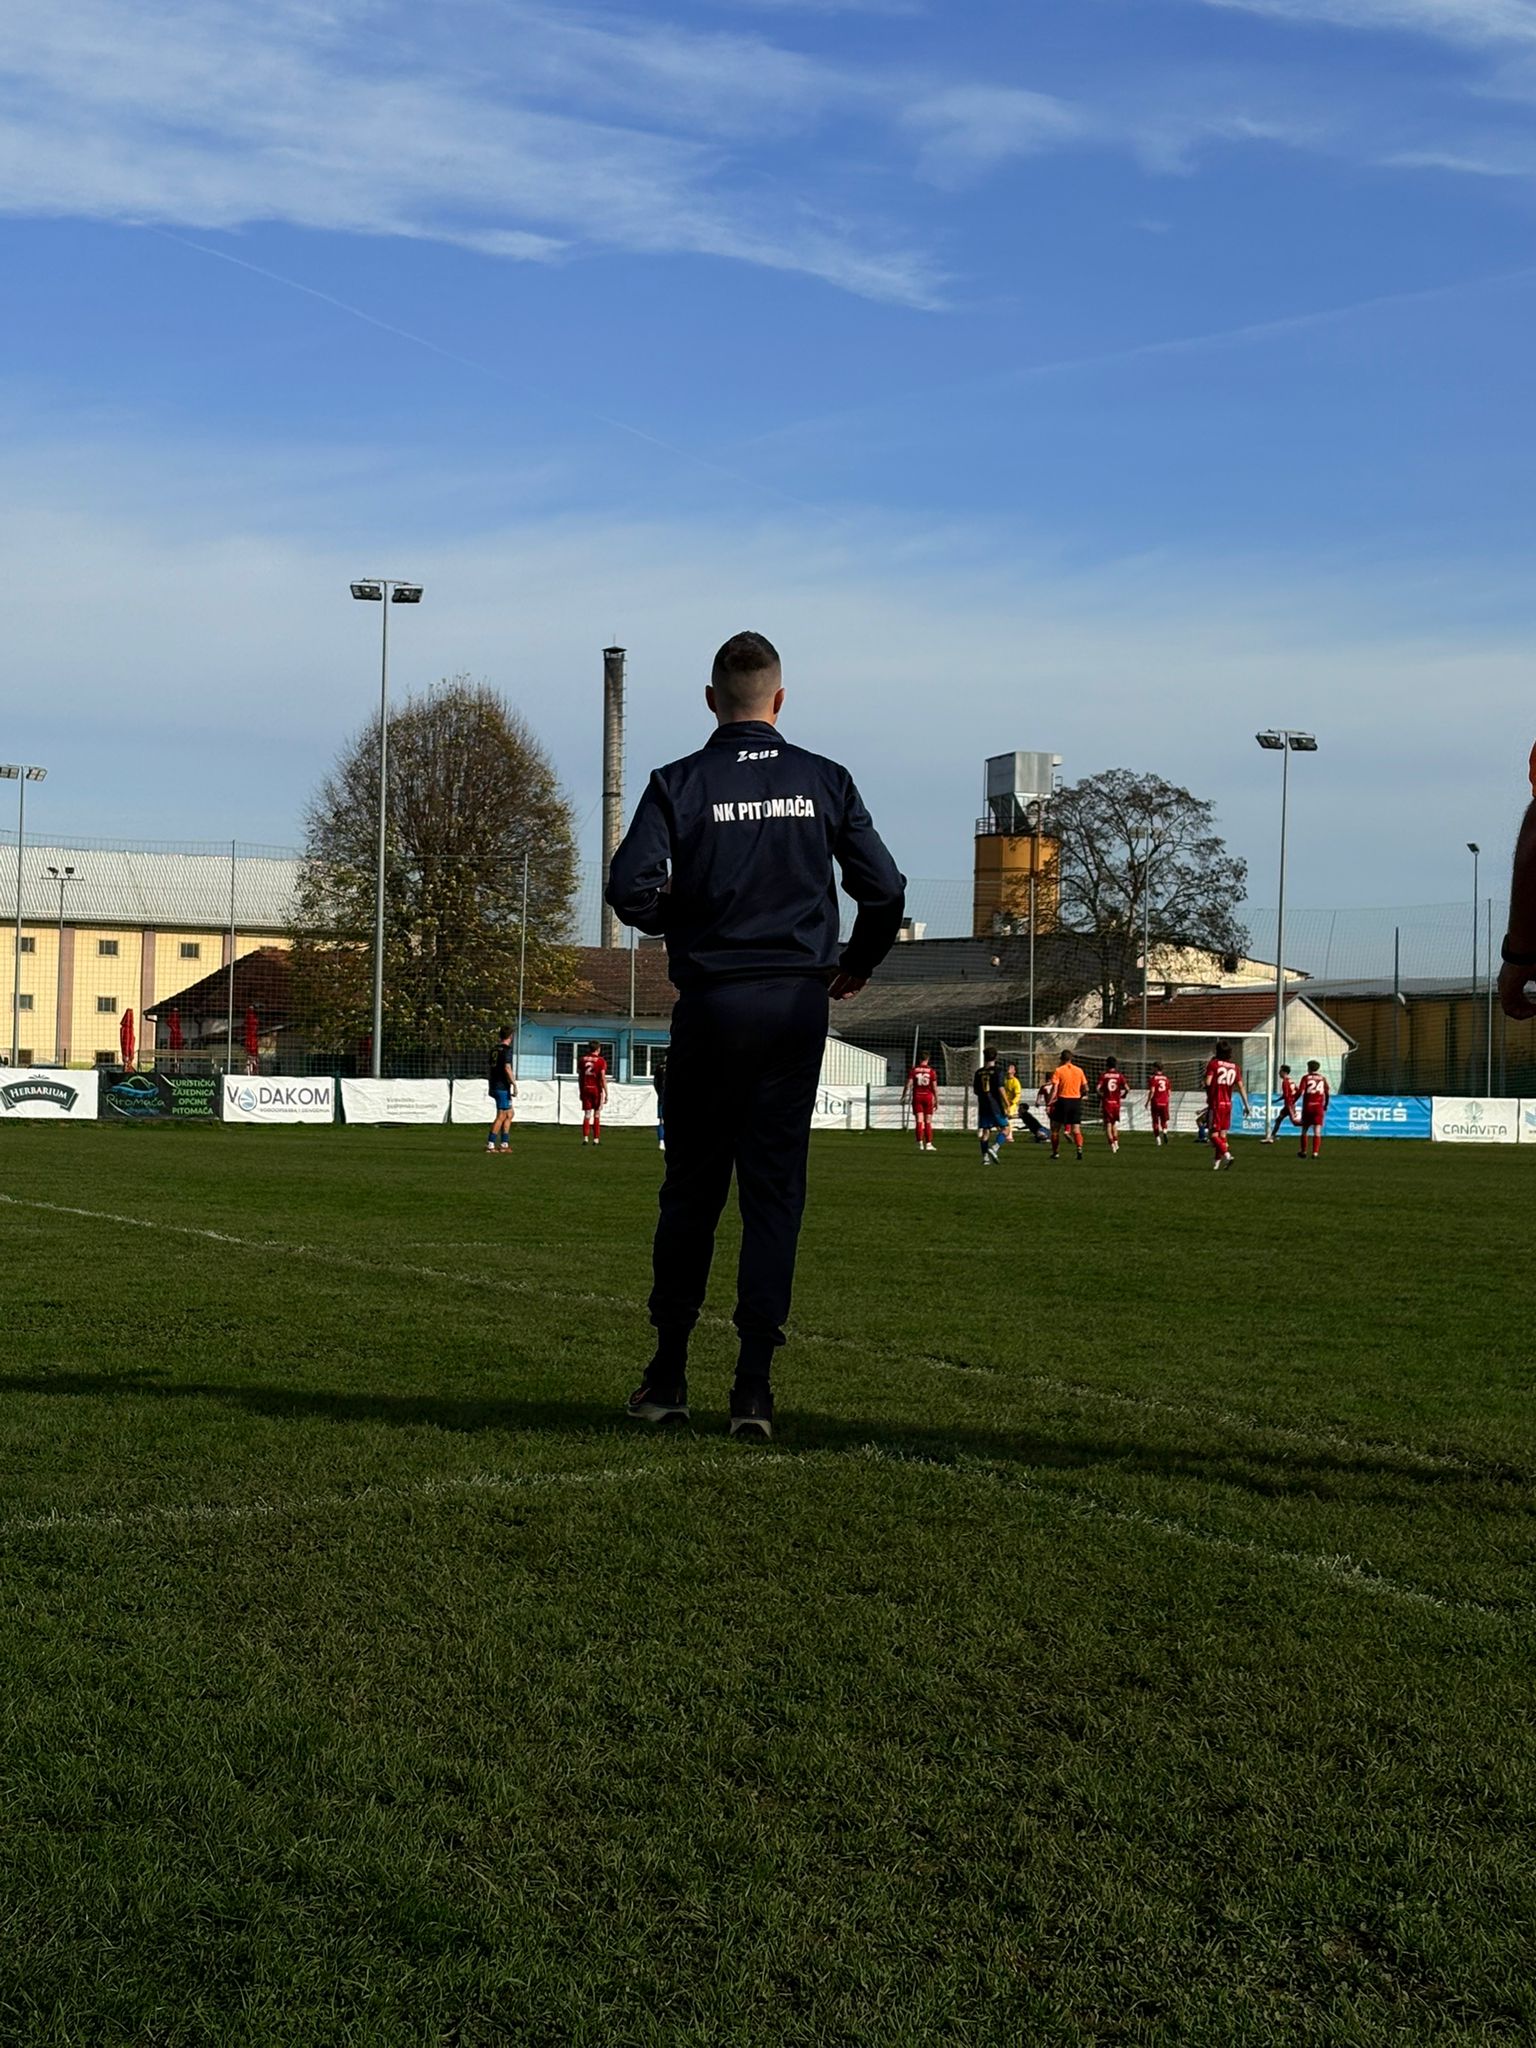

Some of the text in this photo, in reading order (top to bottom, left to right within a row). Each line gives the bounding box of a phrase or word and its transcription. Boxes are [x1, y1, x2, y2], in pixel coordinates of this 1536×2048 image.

[736, 749, 779, 763] Zeus
[712, 795, 815, 822] NK PITOMAČA
[584, 1062, 595, 1075] 2
[915, 1073, 931, 1086] 16
[1217, 1067, 1236, 1086] 20
[1107, 1078, 1117, 1092] 6
[1158, 1080, 1166, 1092] 3
[1307, 1080, 1324, 1094] 24
[9, 1086, 68, 1101] HERBARIUM
[1348, 1106, 1392, 1121] ERSTE
[1348, 1121, 1370, 1131] Bank
